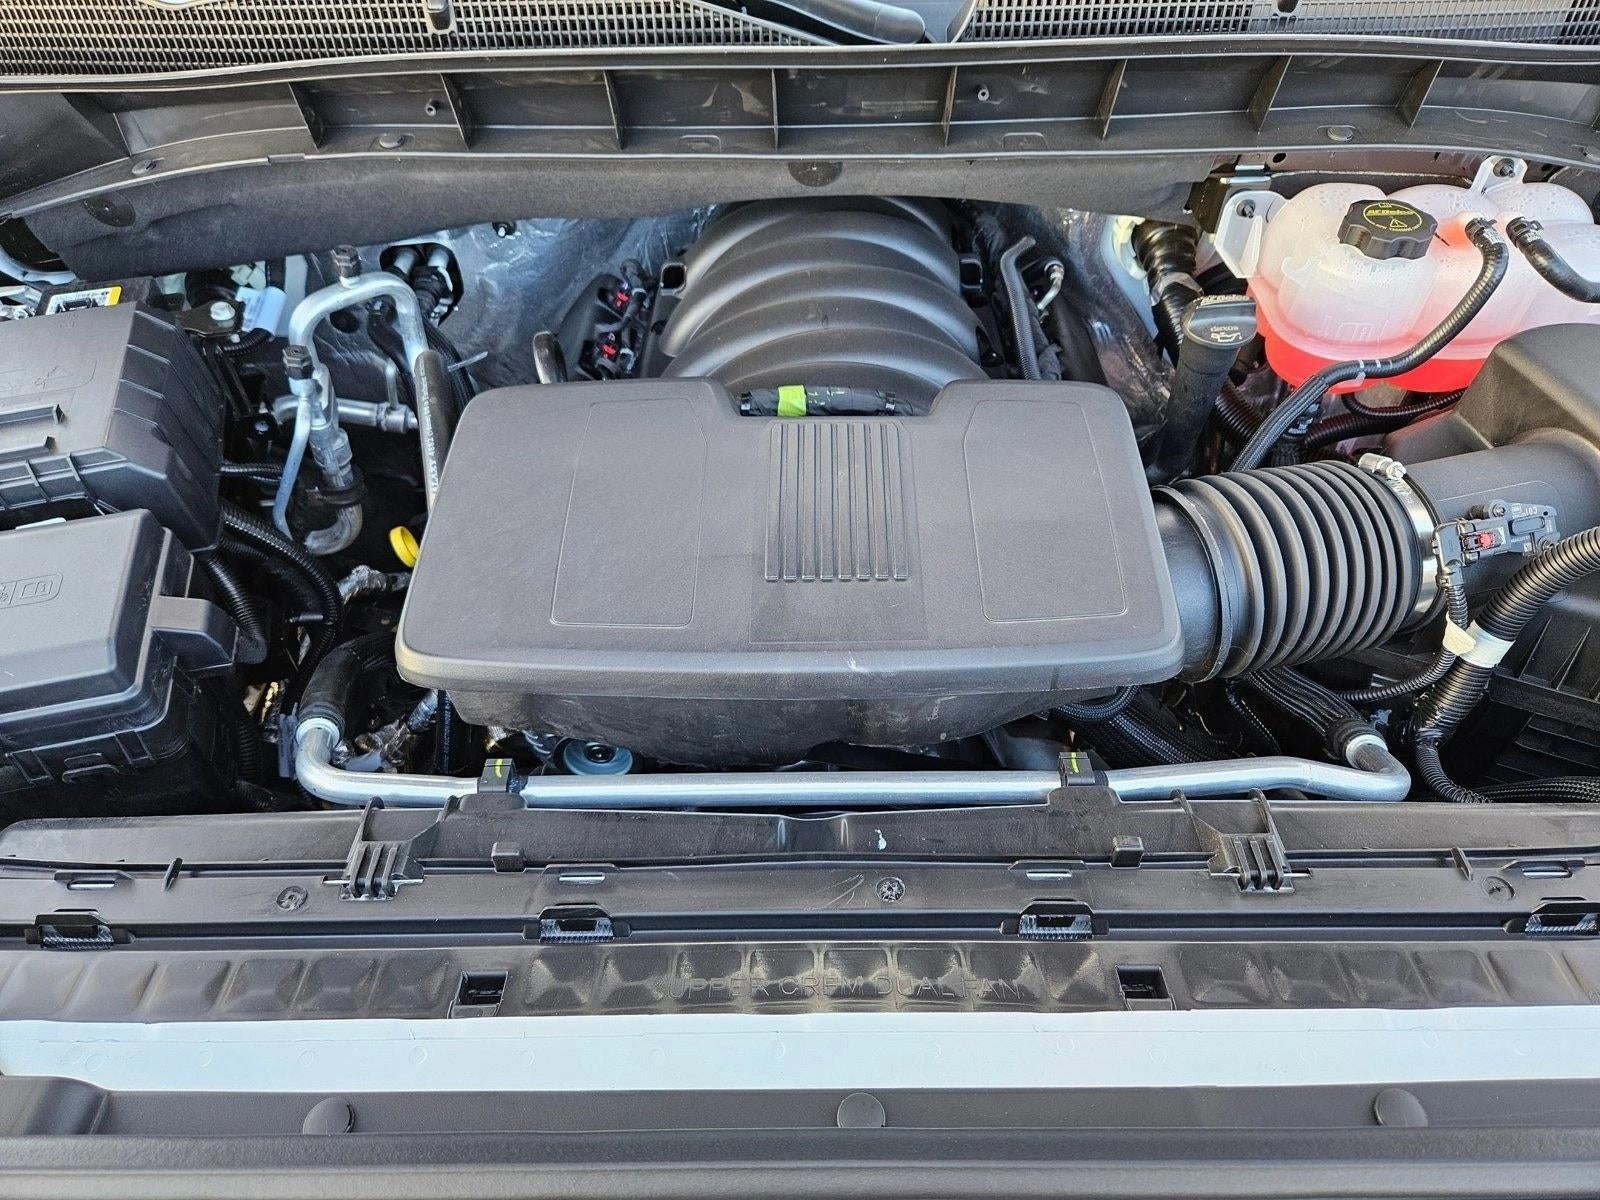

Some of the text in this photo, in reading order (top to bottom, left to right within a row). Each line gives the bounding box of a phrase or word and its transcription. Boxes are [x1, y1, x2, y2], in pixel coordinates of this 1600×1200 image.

[668, 976, 770, 999] UPPER
[875, 976, 955, 998] DUAL
[961, 977, 1025, 1000] FAN
